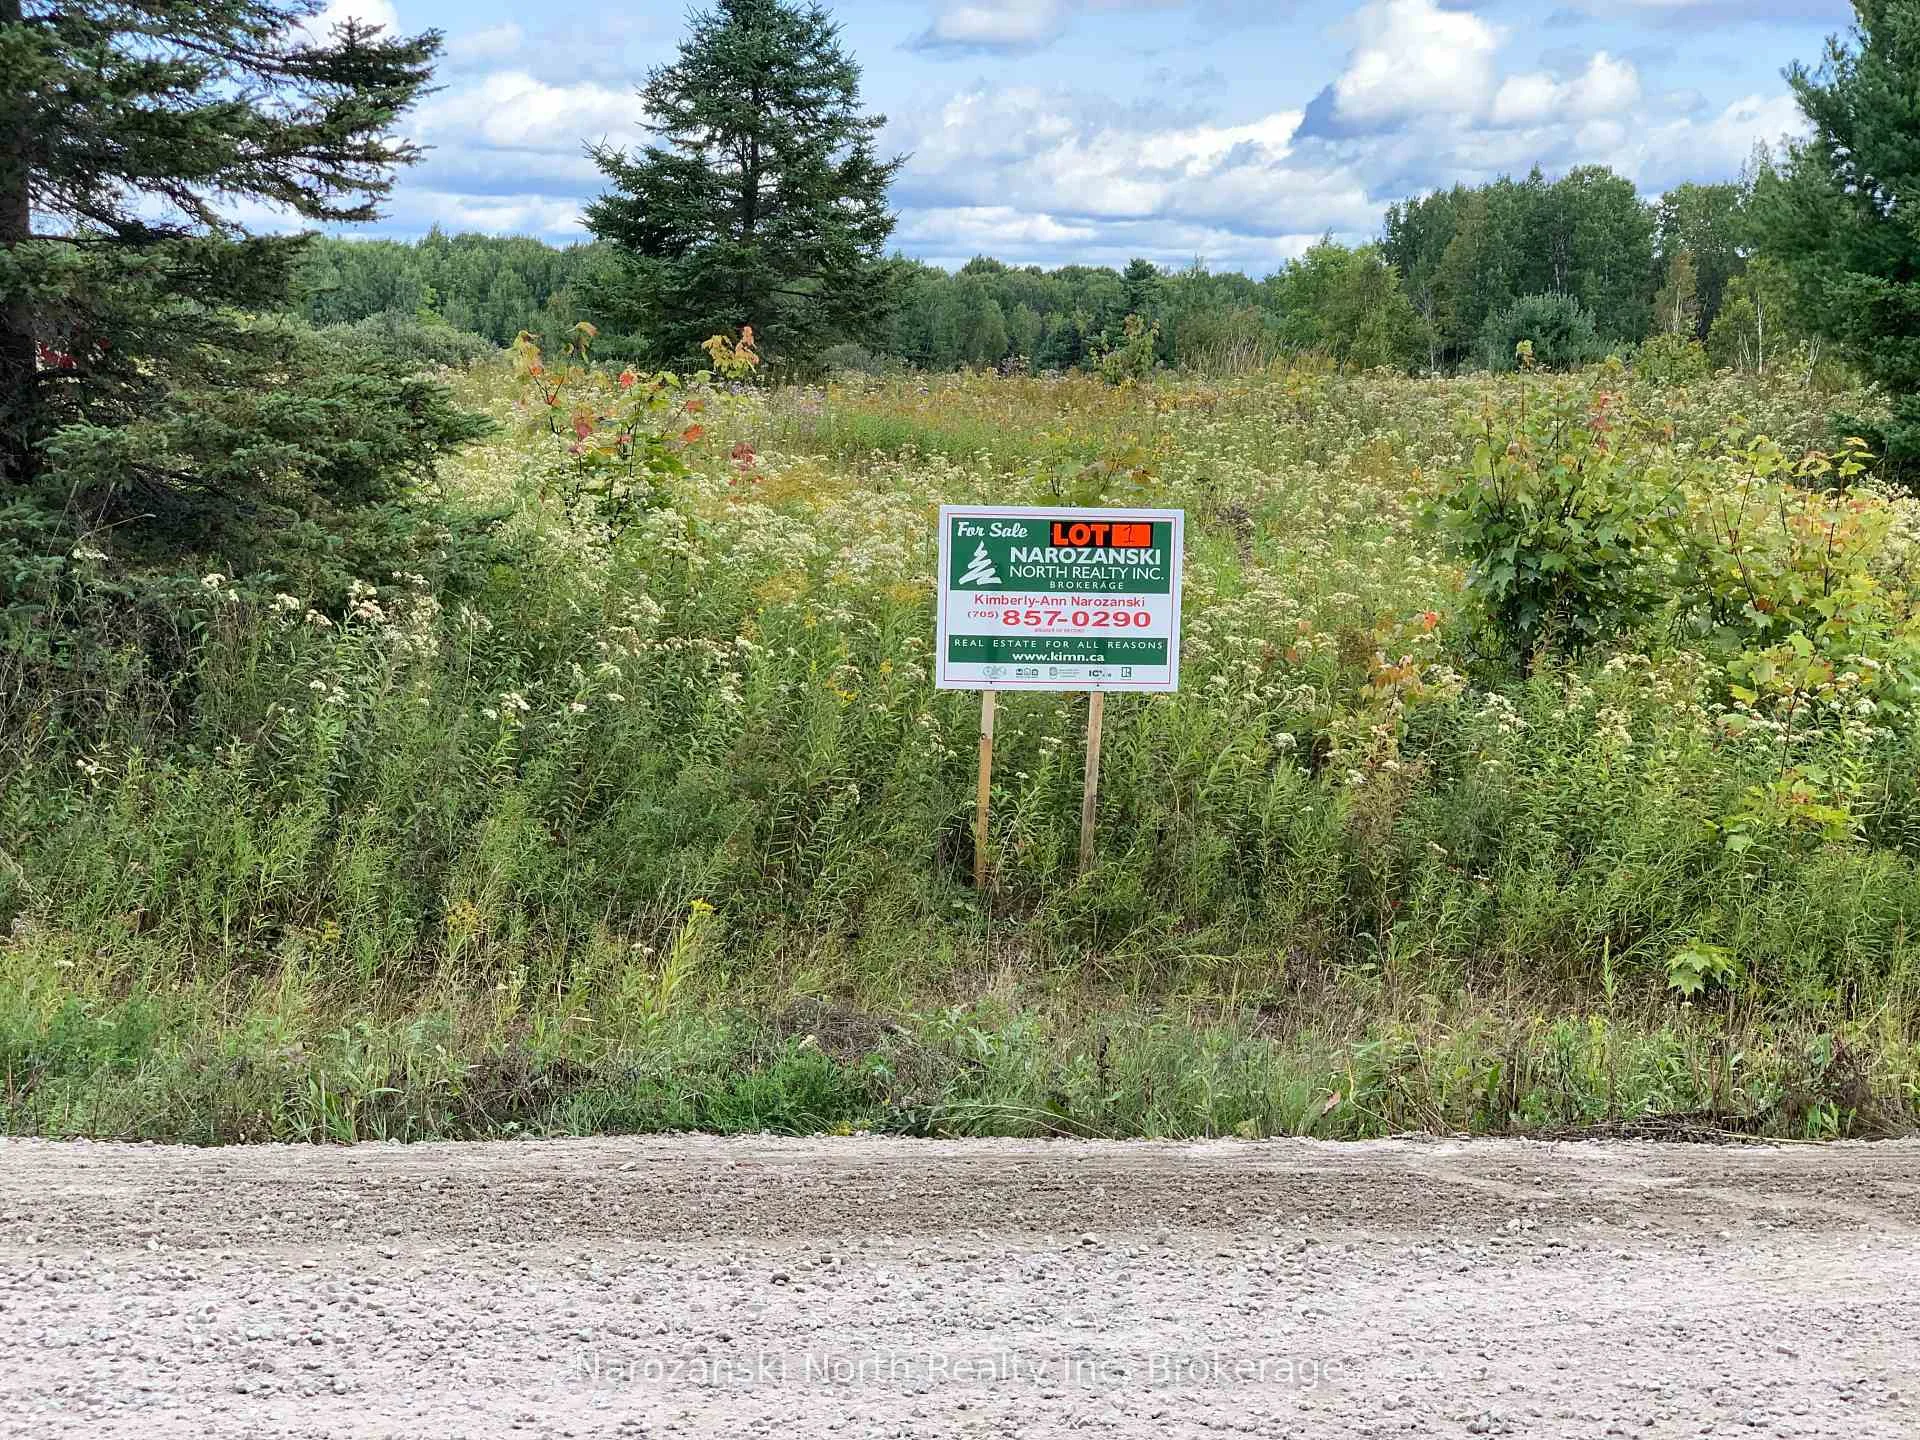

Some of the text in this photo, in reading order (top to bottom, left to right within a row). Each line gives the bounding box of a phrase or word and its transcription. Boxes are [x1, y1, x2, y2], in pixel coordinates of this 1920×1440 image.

[957, 521, 1029, 538] For Sale
[1053, 523, 1110, 546] LOT
[1010, 547, 1162, 565] NAROZANSKI
[1009, 565, 1165, 580] NORTH REALTY INC.
[1050, 581, 1124, 590] BROKERAGE
[974, 594, 1145, 608] Kimberly-Ann Narozanski
[967, 609, 1151, 628] (705) 857-0290
[954, 639, 1164, 650] REAL ESTATE FOR ALL REASONS
[1012, 652, 1105, 662] www.kimn.ca
